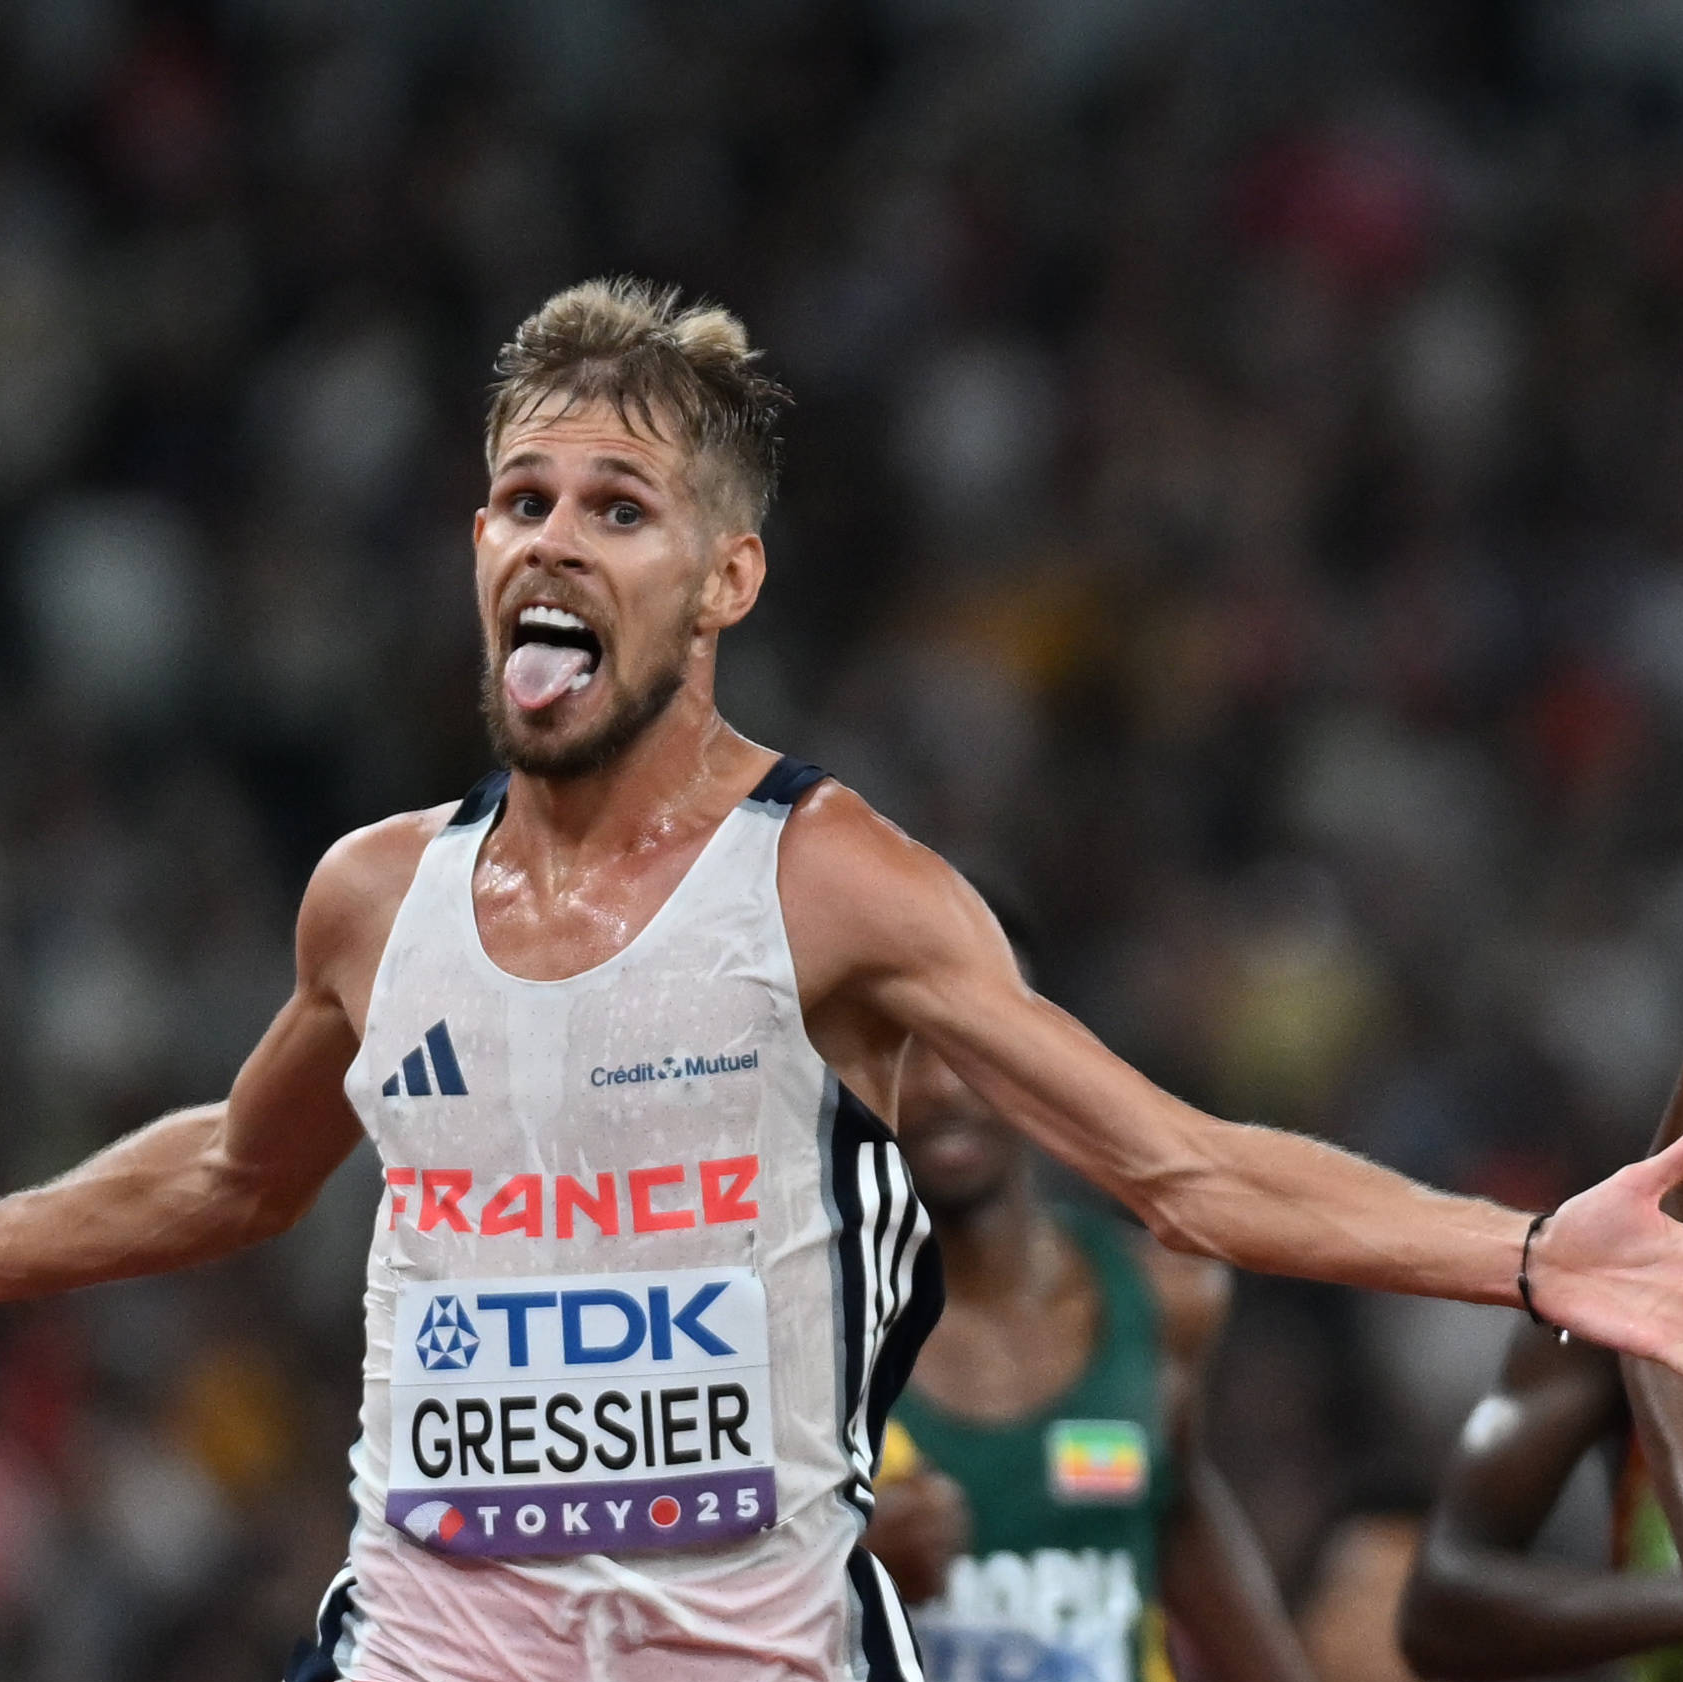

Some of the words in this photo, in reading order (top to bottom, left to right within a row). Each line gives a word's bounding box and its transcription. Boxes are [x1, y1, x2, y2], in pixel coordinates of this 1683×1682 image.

[590, 1063, 656, 1088] Crédit
[684, 1049, 759, 1077] Mutuel
[386, 1154, 760, 1240] FRANCE
[476, 1281, 739, 1368] TDK
[411, 1382, 752, 1479] GRESSIER
